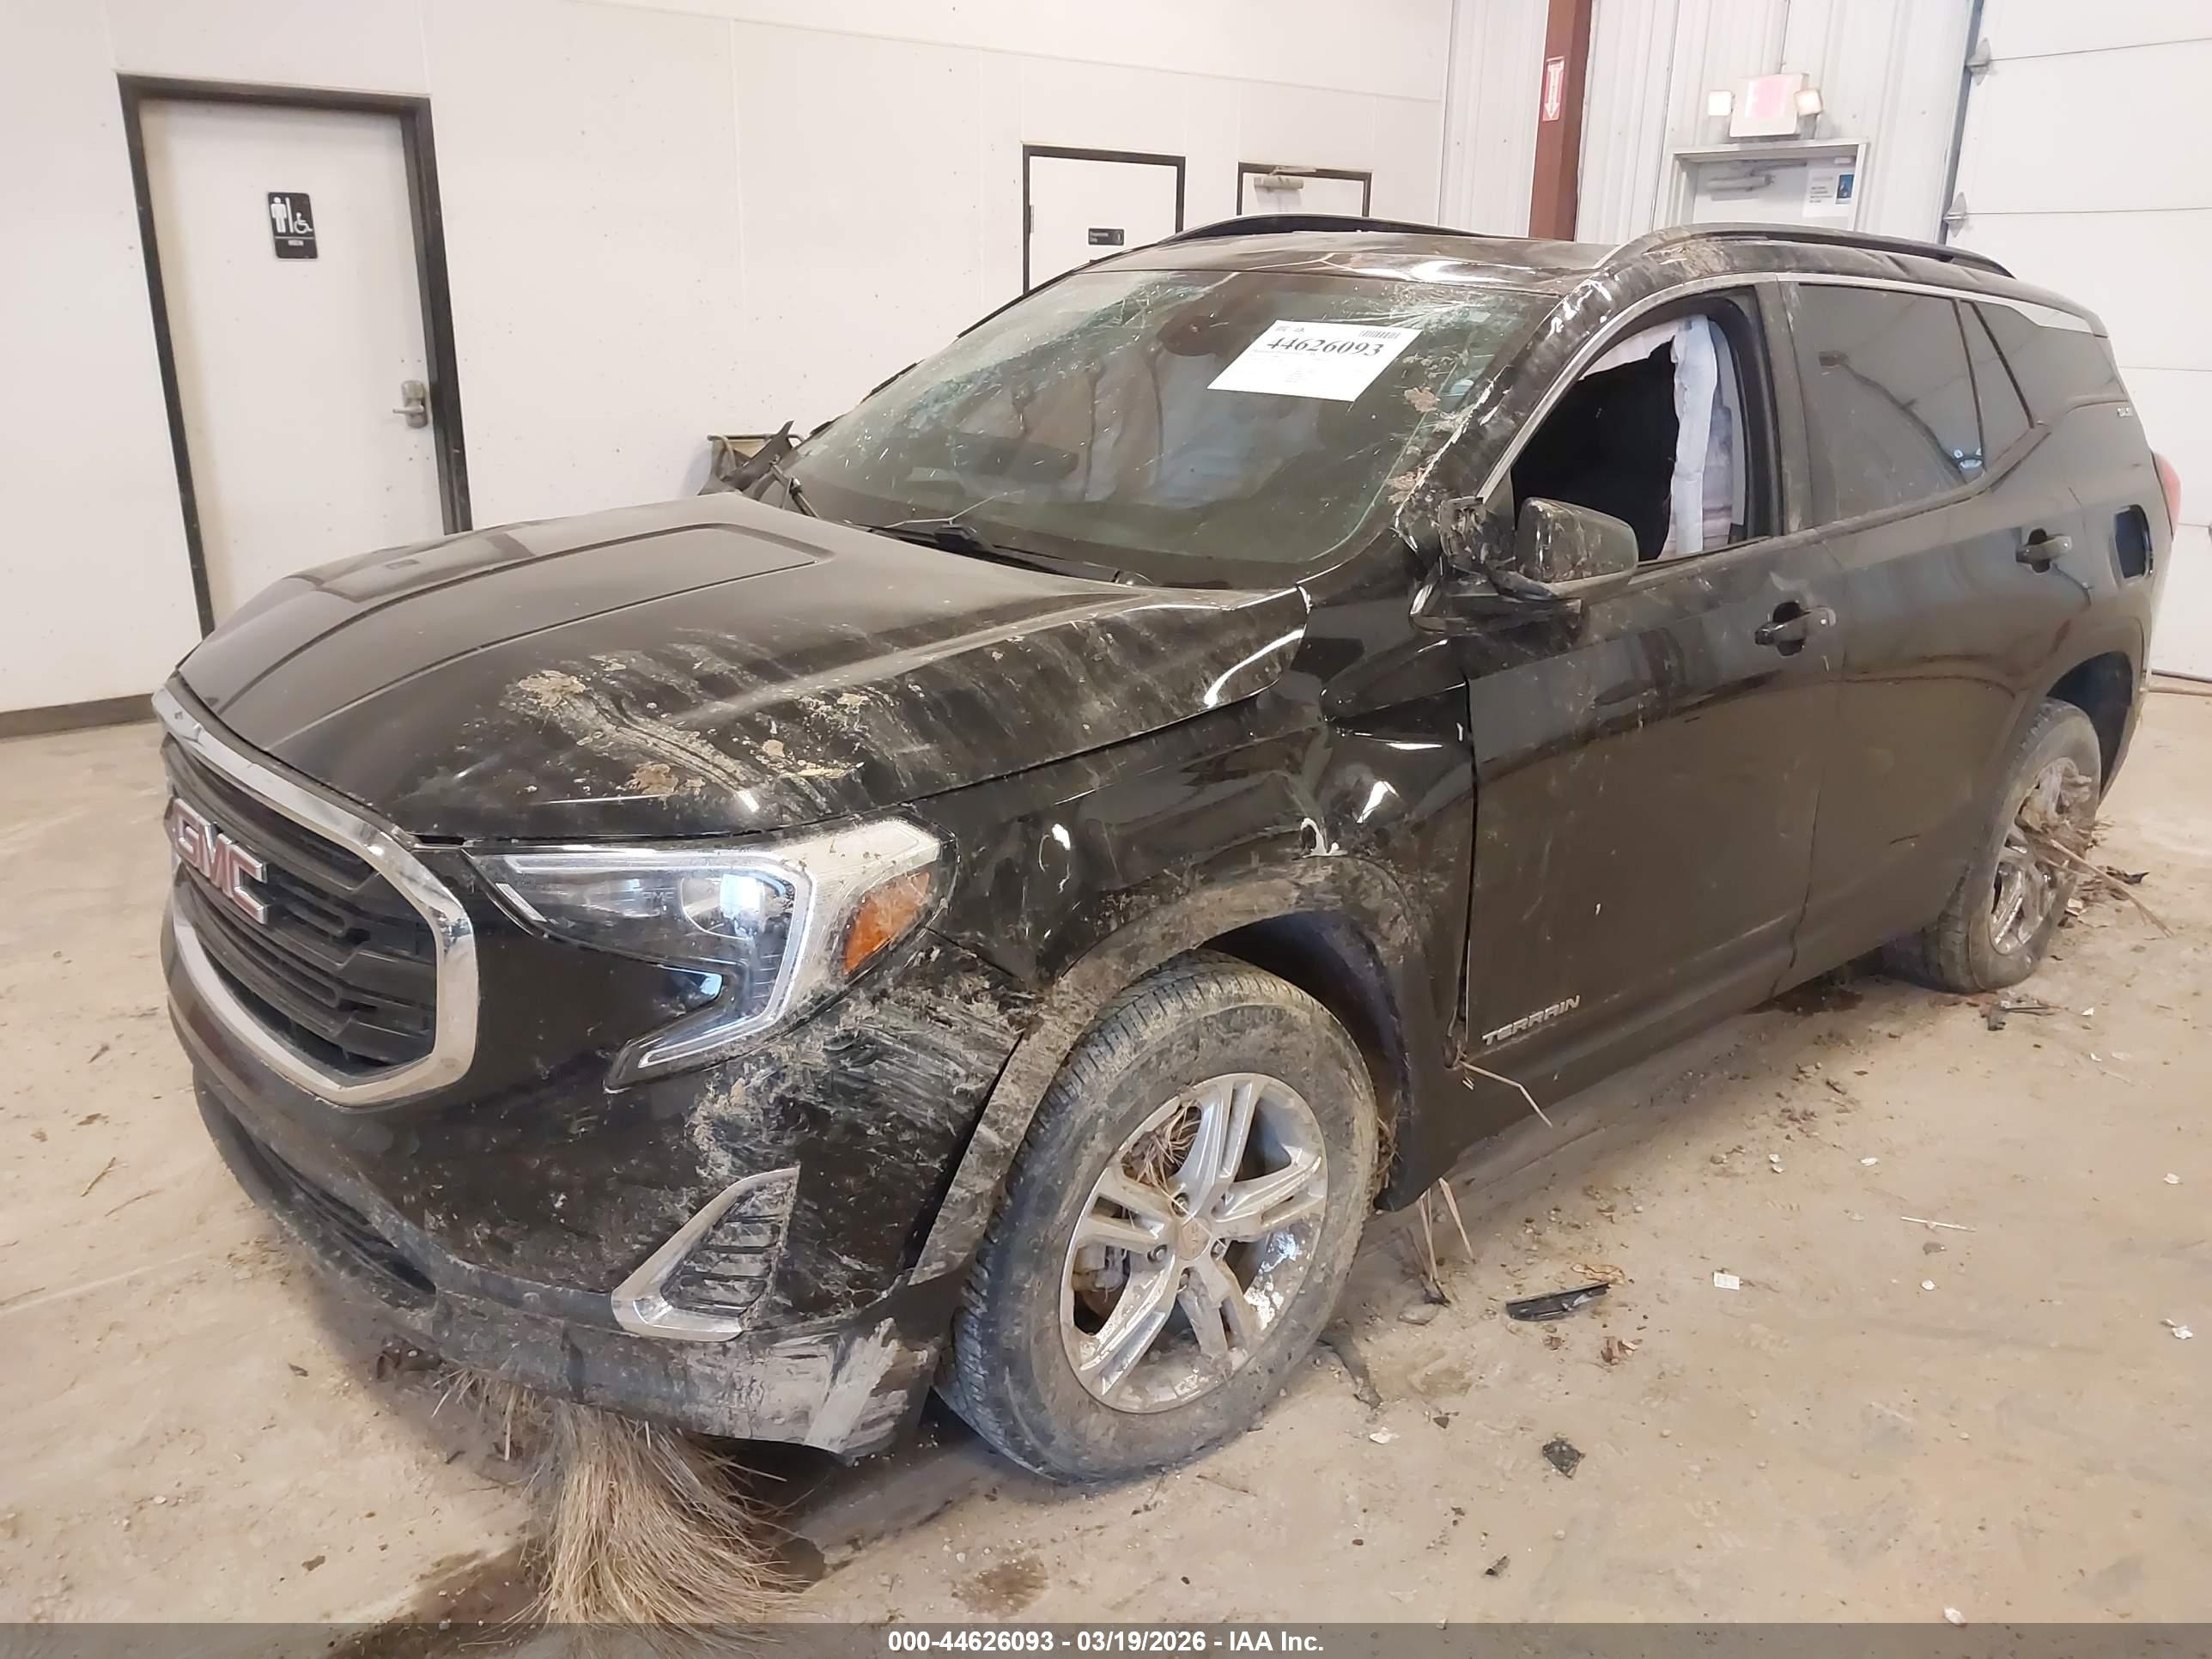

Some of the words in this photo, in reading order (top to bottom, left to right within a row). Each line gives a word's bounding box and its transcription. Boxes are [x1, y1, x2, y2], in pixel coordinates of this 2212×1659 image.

[1267, 337, 1385, 356] 44626093
[172, 798, 268, 925] GMC
[1482, 994, 1581, 1046] TERRAIN
